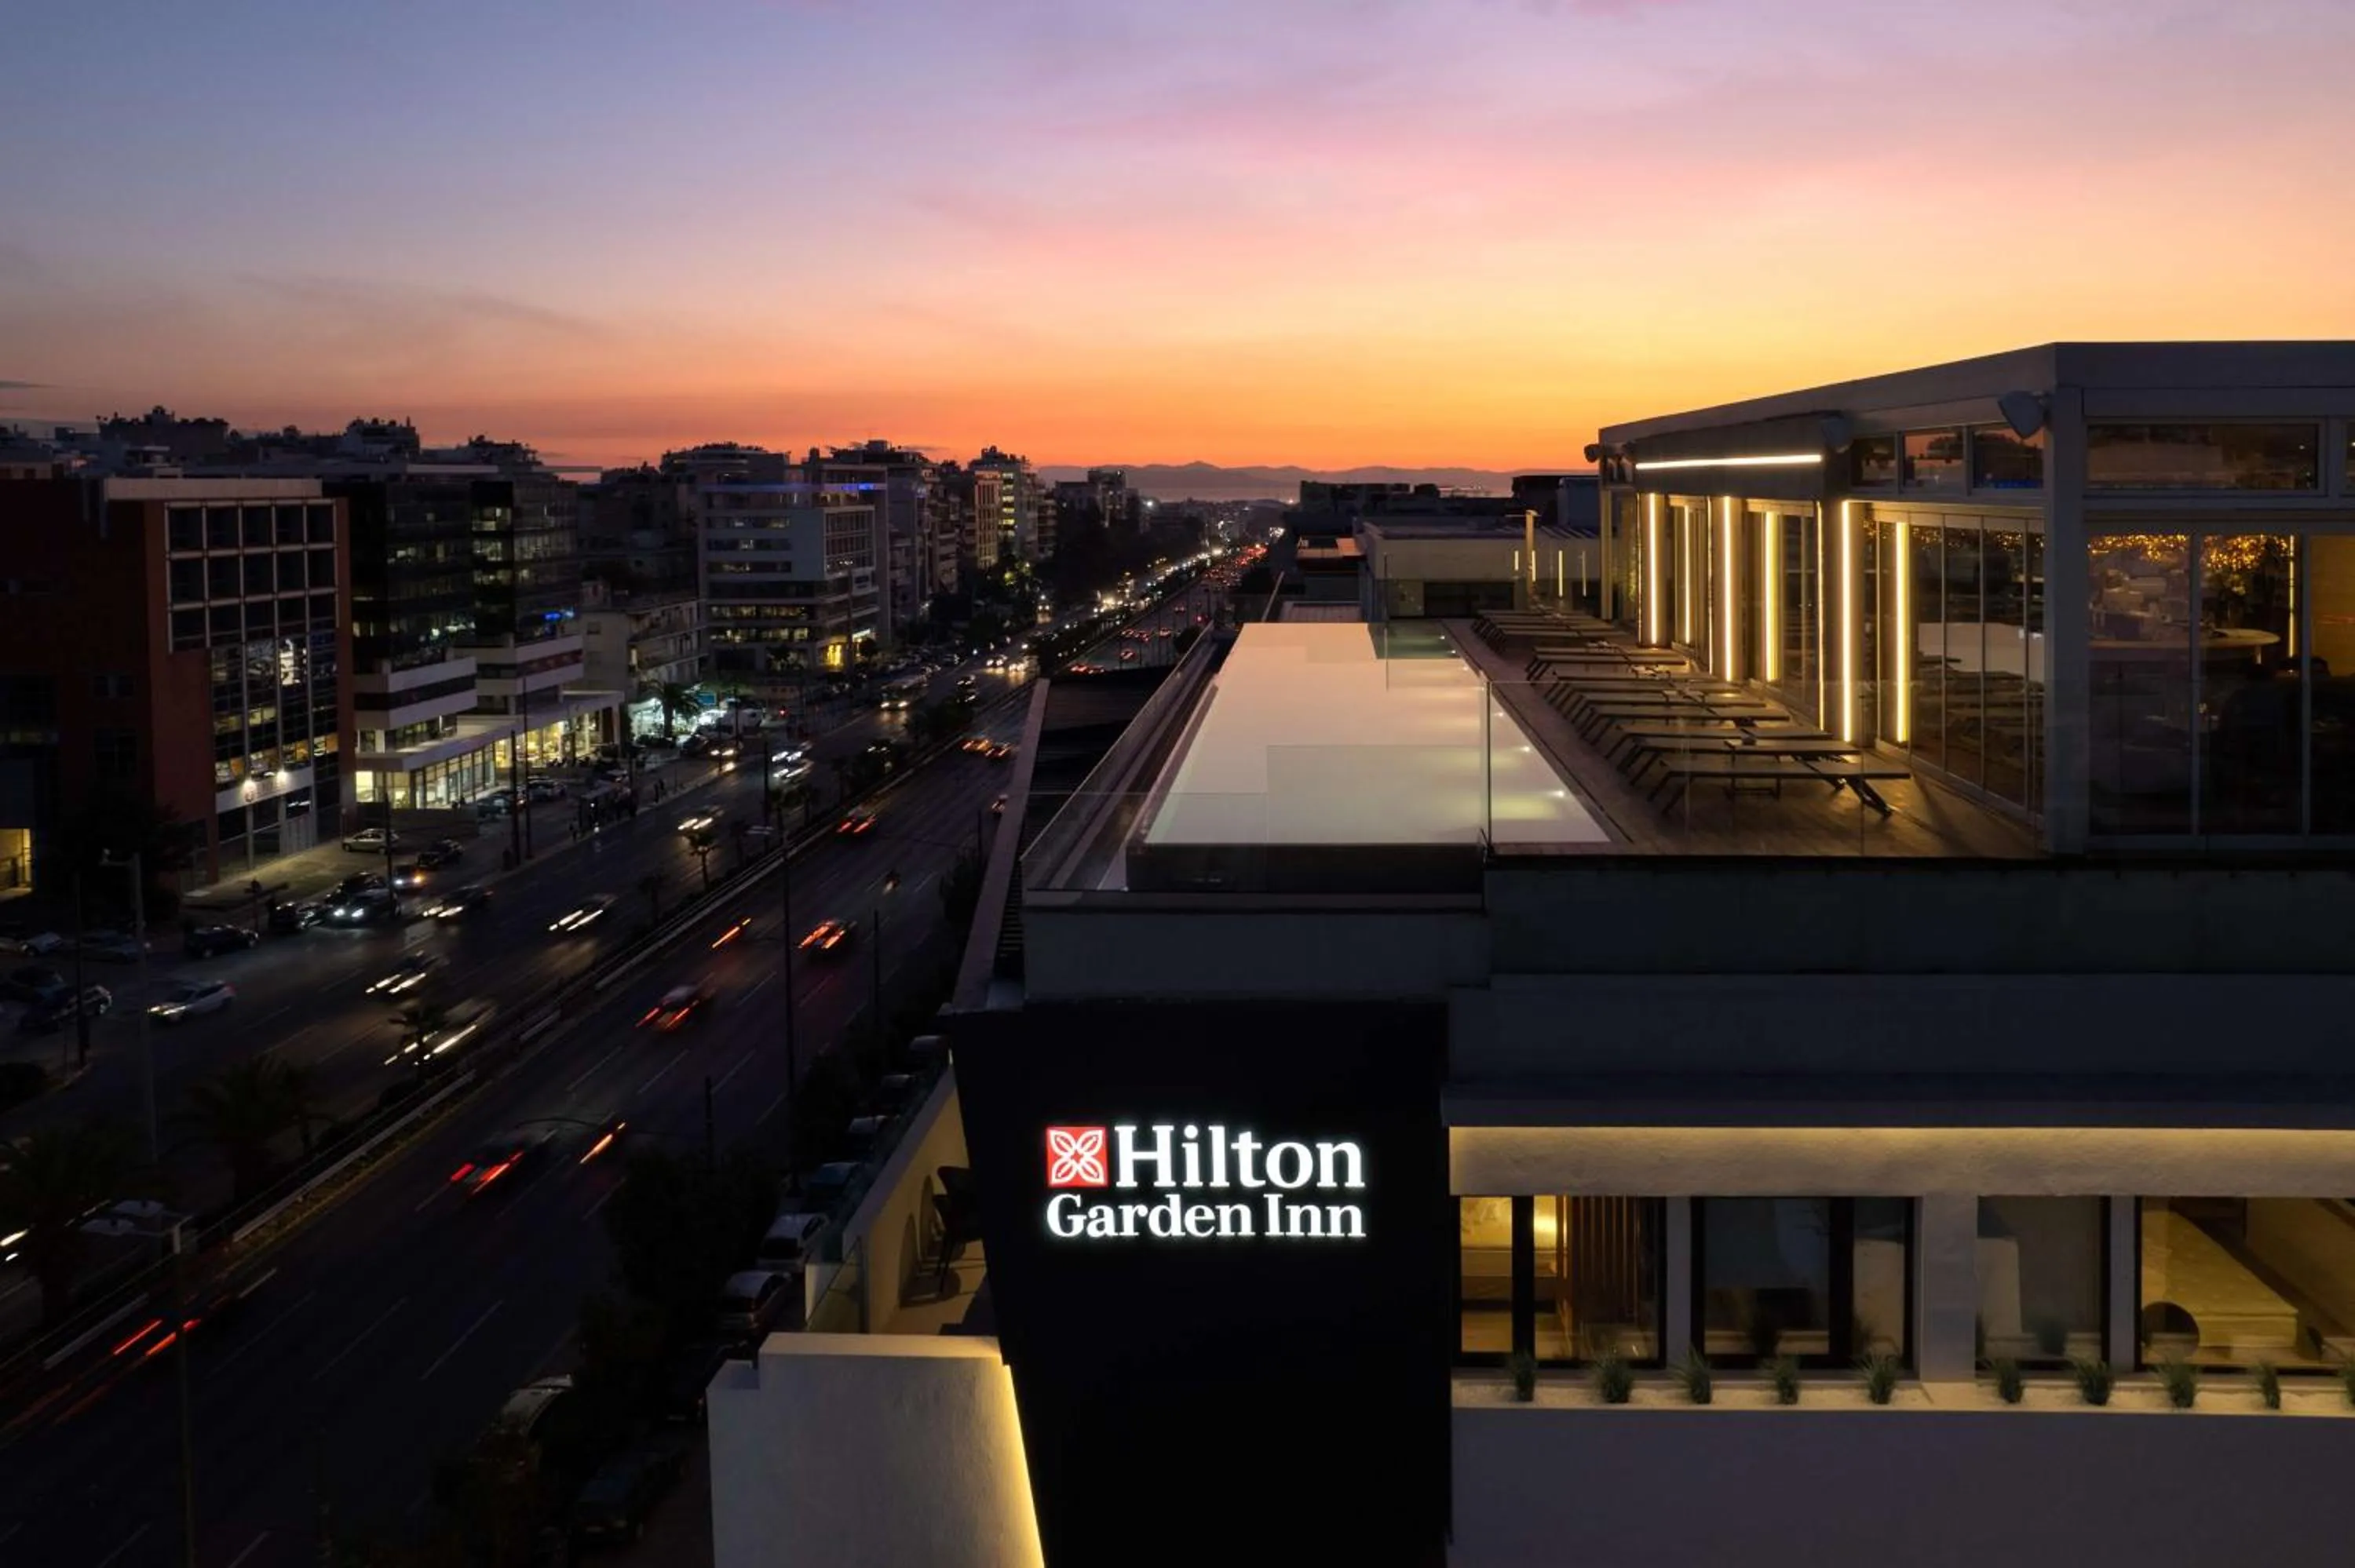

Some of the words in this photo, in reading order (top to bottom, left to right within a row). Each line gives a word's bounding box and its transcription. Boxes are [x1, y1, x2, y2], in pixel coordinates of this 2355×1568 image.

[1115, 1125, 1365, 1188] Hilton
[1047, 1194, 1256, 1238] Garden
[1263, 1194, 1367, 1237] Inn
